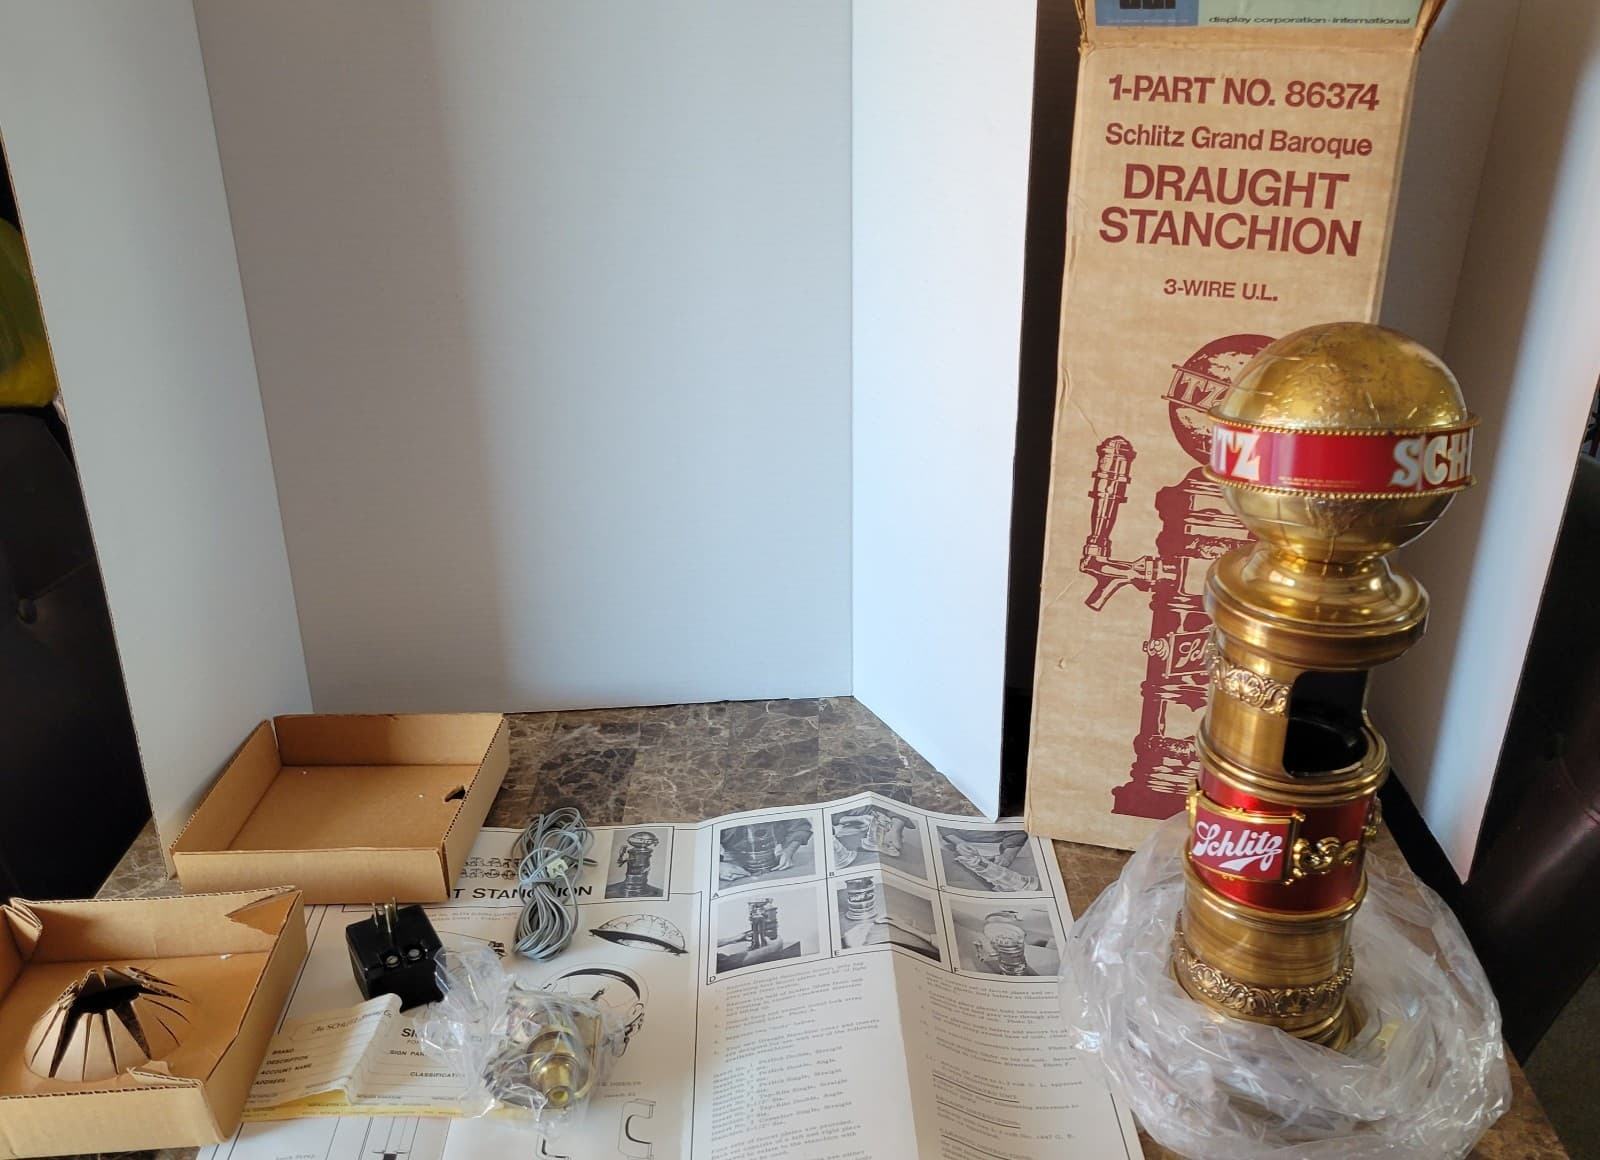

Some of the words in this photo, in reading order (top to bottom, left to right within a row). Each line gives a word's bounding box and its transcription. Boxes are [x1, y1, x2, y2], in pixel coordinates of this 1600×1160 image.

[1208, 16, 1252, 25] display
[1108, 74, 1215, 104] 1-PART
[1223, 78, 1276, 107] NO.
[1285, 80, 1380, 111] 86374
[1105, 122, 1185, 147] Schlitz
[1192, 126, 1264, 151] Grand
[1269, 130, 1373, 159] Baroque
[1123, 163, 1350, 210] DRAUGHT
[1099, 206, 1362, 257] STANCHION
[1163, 278, 1236, 299] 3-WIRE
[1242, 282, 1279, 302] U.L.
[1192, 820, 1283, 872] Schlitz
[472, 886, 592, 899] STANCION
